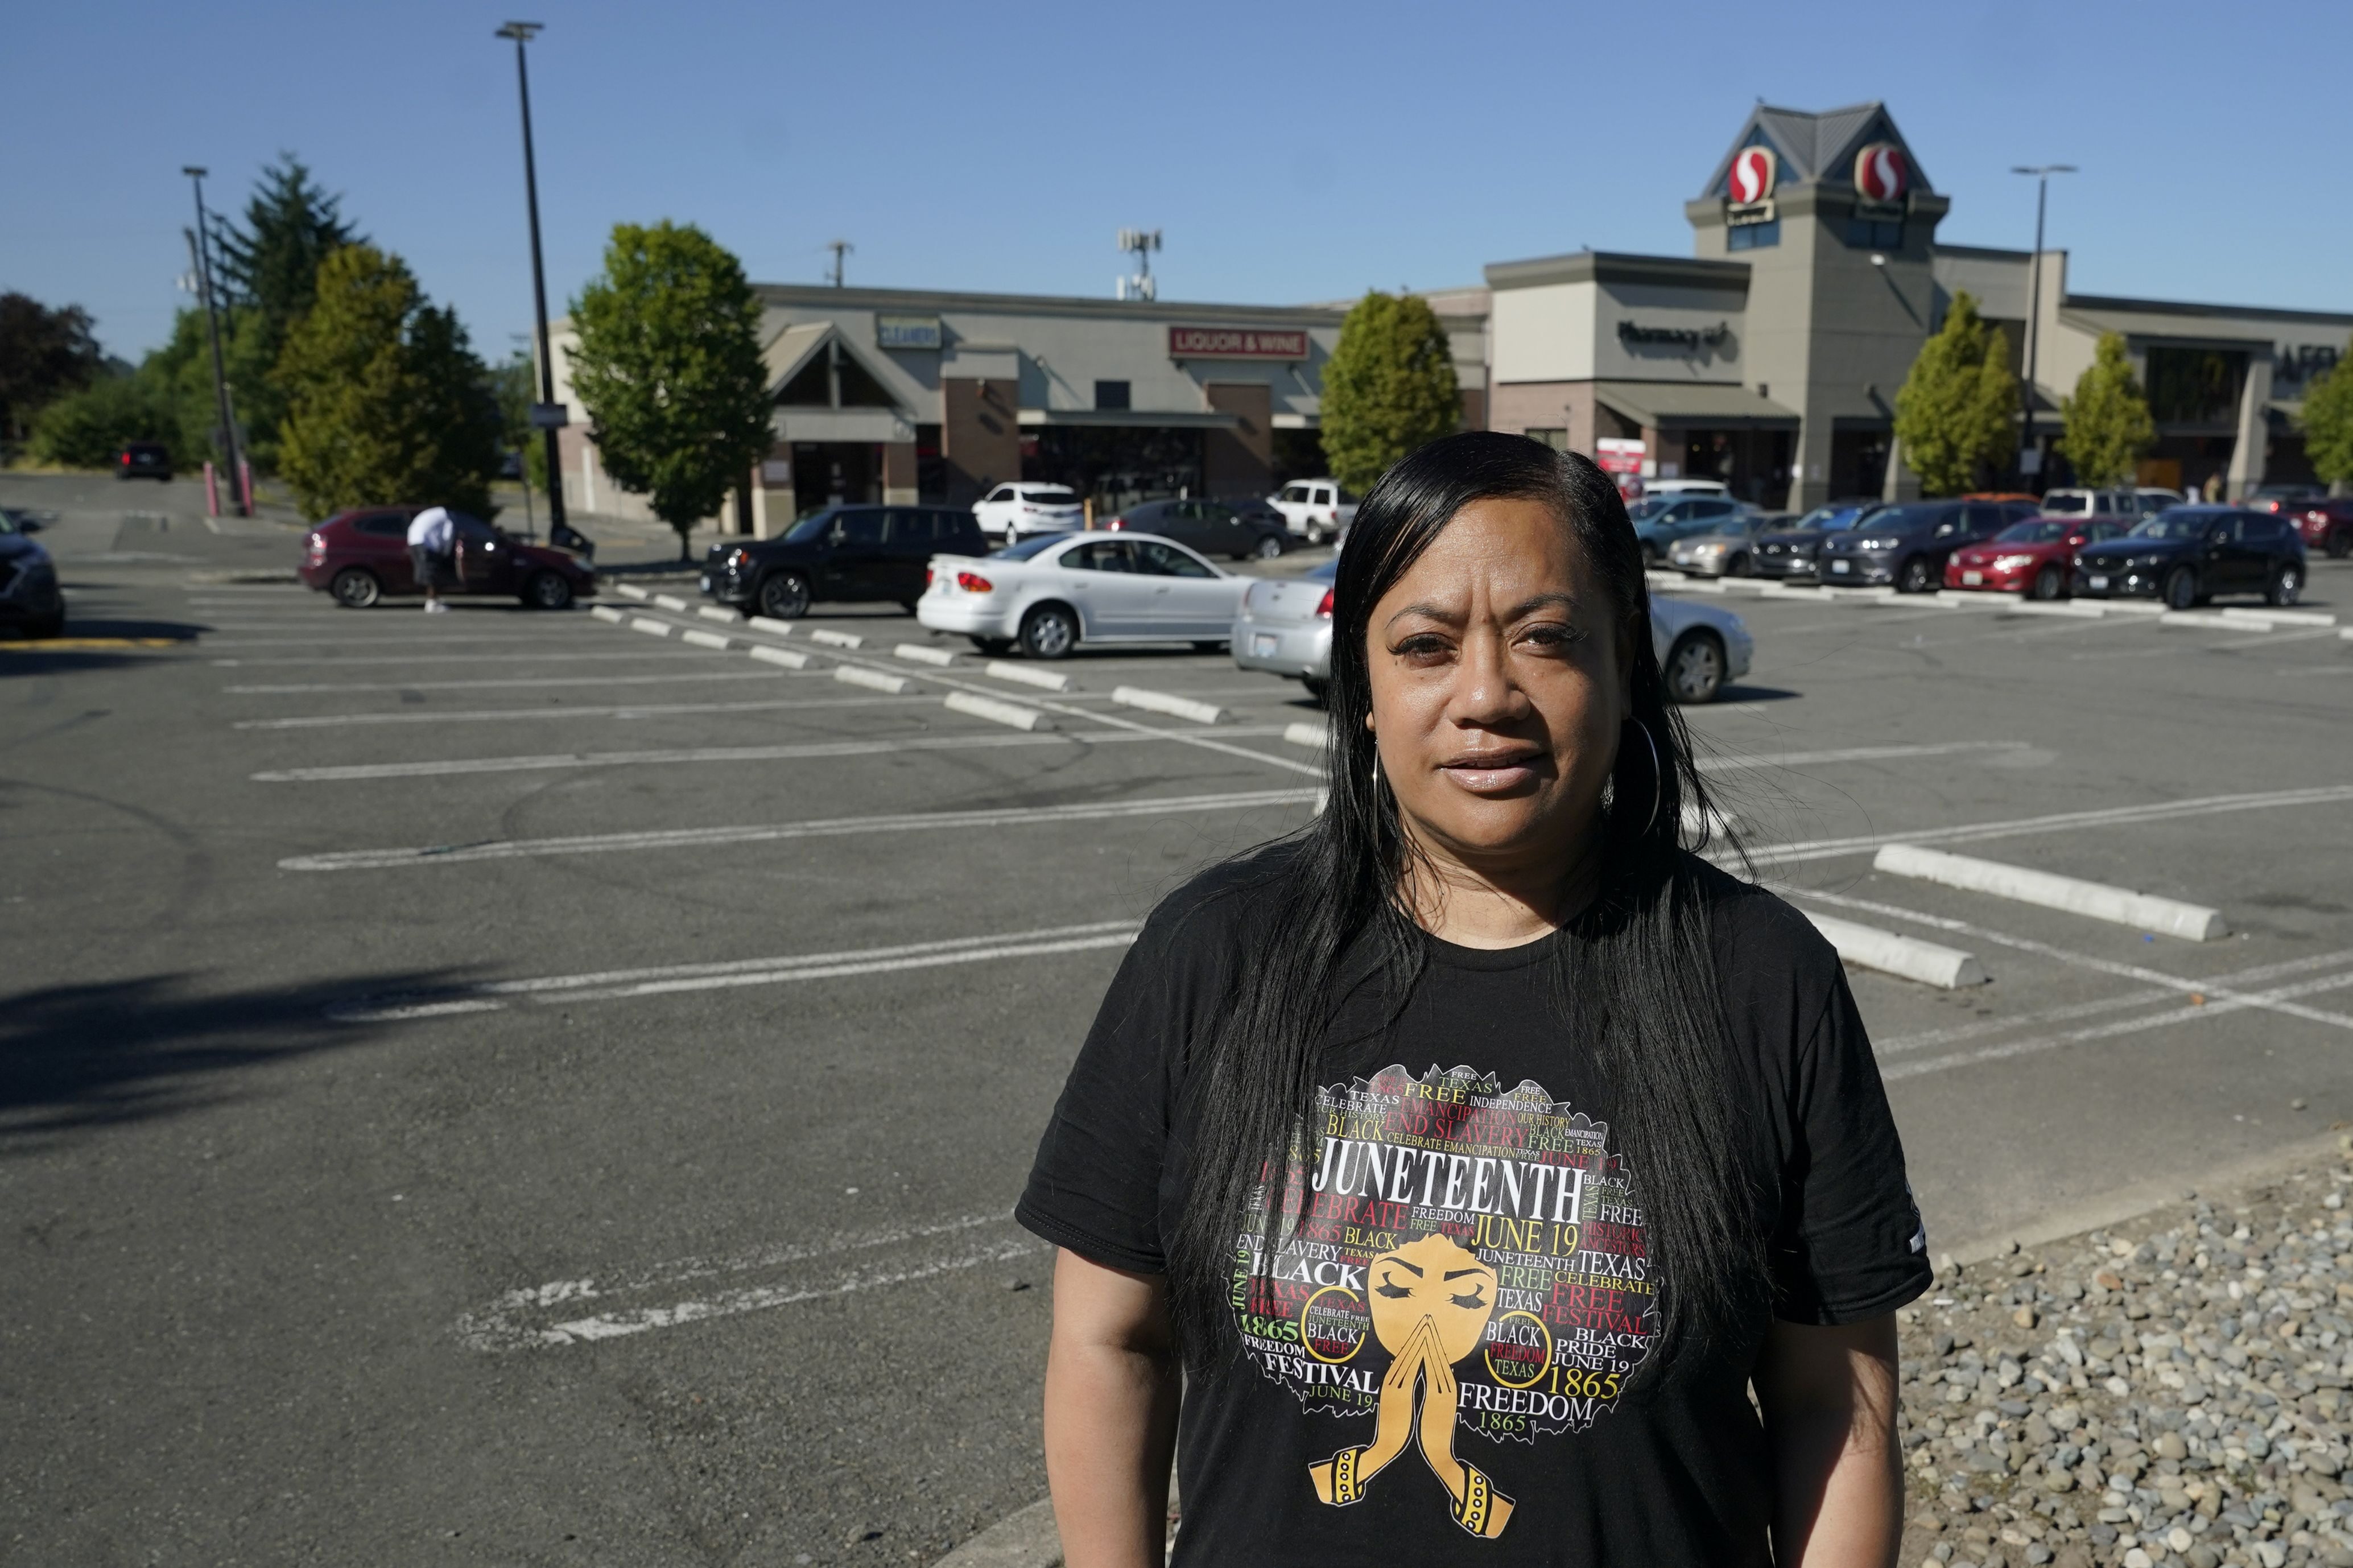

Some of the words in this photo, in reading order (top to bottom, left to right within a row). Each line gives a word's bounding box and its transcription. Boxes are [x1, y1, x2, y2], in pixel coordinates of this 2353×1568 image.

[1175, 332, 1242, 351] LIQUOR
[1243, 333, 1257, 351] &
[1257, 334, 1302, 353] WINE
[1439, 1076, 1493, 1094] TEXAS
[1452, 1071, 1478, 1080] FREE
[1351, 1090, 1400, 1104] TEXAS
[1403, 1083, 1466, 1104] FREE
[1514, 1094, 1547, 1103] FREE
[1520, 1085, 1541, 1095] FREE
[1315, 1095, 1388, 1115] CELEBRATE
[1340, 1109, 1388, 1121] HISTORY
[1401, 1097, 1518, 1125] EMANCIPATION
[1469, 1095, 1552, 1114] INDEPENDENCE
[1326, 1113, 1386, 1141] BLACK
[1384, 1112, 1428, 1136] END
[1434, 1119, 1529, 1148] SLAVERY
[1517, 1113, 1533, 1125] OUR
[1537, 1113, 1571, 1128] HISTORY
[1529, 1124, 1565, 1139] BLACK
[1564, 1128, 1603, 1140] EMANCIPATION
[1387, 1132, 1442, 1150] CELEBRATE
[1444, 1140, 1516, 1158] EMANCIPATION
[1528, 1136, 1574, 1154] FREE
[1576, 1138, 1602, 1148] TEXAS
[1576, 1146, 1601, 1156] 1865
[1538, 1150, 1591, 1170] JUNE
[1311, 1137, 1586, 1224] JUNETEENTH
[1583, 1174, 1625, 1189] BLACK
[1601, 1187, 1625, 1196] FREE
[1601, 1195, 1633, 1207] TEXAS
[1582, 1185, 1600, 1220] TEXAS
[1411, 1206, 1475, 1225] FREEDOM
[1600, 1204, 1643, 1227] FREE
[1298, 1220, 1343, 1241] 1865
[1344, 1225, 1398, 1251] BLACK
[1410, 1219, 1437, 1232] FREE
[1440, 1222, 1475, 1237] TEXAS
[1471, 1214, 1544, 1253] JUNE
[1550, 1223, 1579, 1257] 19
[1582, 1221, 1644, 1243] HISTORIC
[1236, 1233, 1265, 1251] END
[1578, 1235, 1646, 1258] ANCESTORS
[1237, 1249, 1252, 1265] 19
[1340, 1255, 1370, 1266] FREE
[1344, 1247, 1374, 1259] TEXAS
[1476, 1248, 1576, 1272] JUNETEENTH
[1577, 1249, 1646, 1281] TEXAS
[1232, 1268, 1249, 1310] JUNE
[1499, 1264, 1553, 1291] FREE
[1553, 1269, 1655, 1296] CELEBRATE
[1319, 1295, 1366, 1313] TEXAS
[1497, 1287, 1543, 1313] TEXAS
[1551, 1282, 1625, 1315] FREE
[1308, 1314, 1370, 1331] JUNETEENTH
[1310, 1305, 1350, 1319] CELEBRATE
[1350, 1313, 1370, 1323] FREE
[1508, 1316, 1534, 1326] FREE
[1541, 1303, 1648, 1336] FESTIVAL
[1240, 1314, 1299, 1342] 1865
[1307, 1322, 1359, 1344] BLACK
[1485, 1320, 1541, 1347] BLACK
[1573, 1326, 1648, 1350] BLACK
[1243, 1333, 1306, 1359] FREEDOM
[1314, 1338, 1349, 1355] FREE
[1489, 1342, 1546, 1365] FREEDOM
[1555, 1338, 1617, 1359] PRIDE
[1493, 1358, 1535, 1378] TEXAS
[1551, 1351, 1604, 1371] JUNE
[1610, 1359, 1630, 1373] 19
[1263, 1352, 1380, 1394] FESTIVAL
[1547, 1365, 1621, 1400] 1865
[1309, 1385, 1352, 1402] JUNE
[1356, 1393, 1373, 1408] 19
[1457, 1381, 1596, 1422] FREEDOM
[1479, 1410, 1526, 1432] 1865
